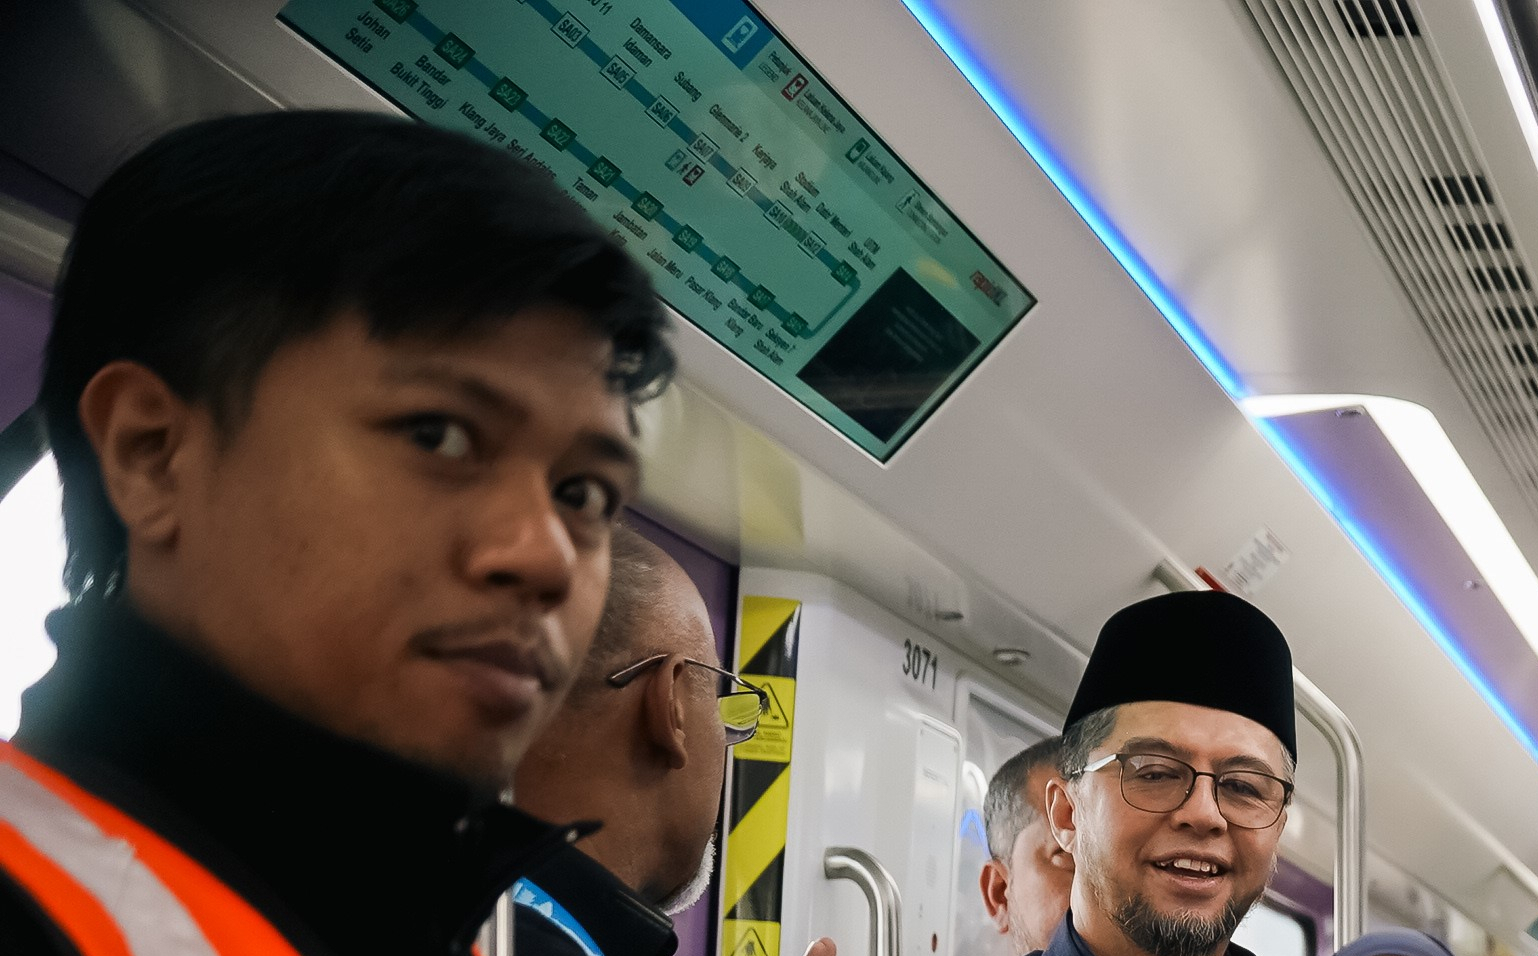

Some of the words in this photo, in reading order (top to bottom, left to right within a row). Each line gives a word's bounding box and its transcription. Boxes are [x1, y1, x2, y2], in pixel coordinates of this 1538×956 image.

[345, 27, 373, 53] Setia
[357, 11, 390, 39] Johan
[556, 17, 583, 44] SA03
[630, 18, 671, 59] Damansara
[623, 37, 652, 67] Idaman
[416, 55, 450, 85] Bandar
[390, 62, 419, 87] Bukit
[417, 81, 447, 109] Tinggi
[674, 71, 701, 102] Subang
[458, 101, 486, 129] Klang
[483, 123, 506, 143] Jaya
[573, 177, 598, 201] Taman
[902, 638, 938, 690] 3071
